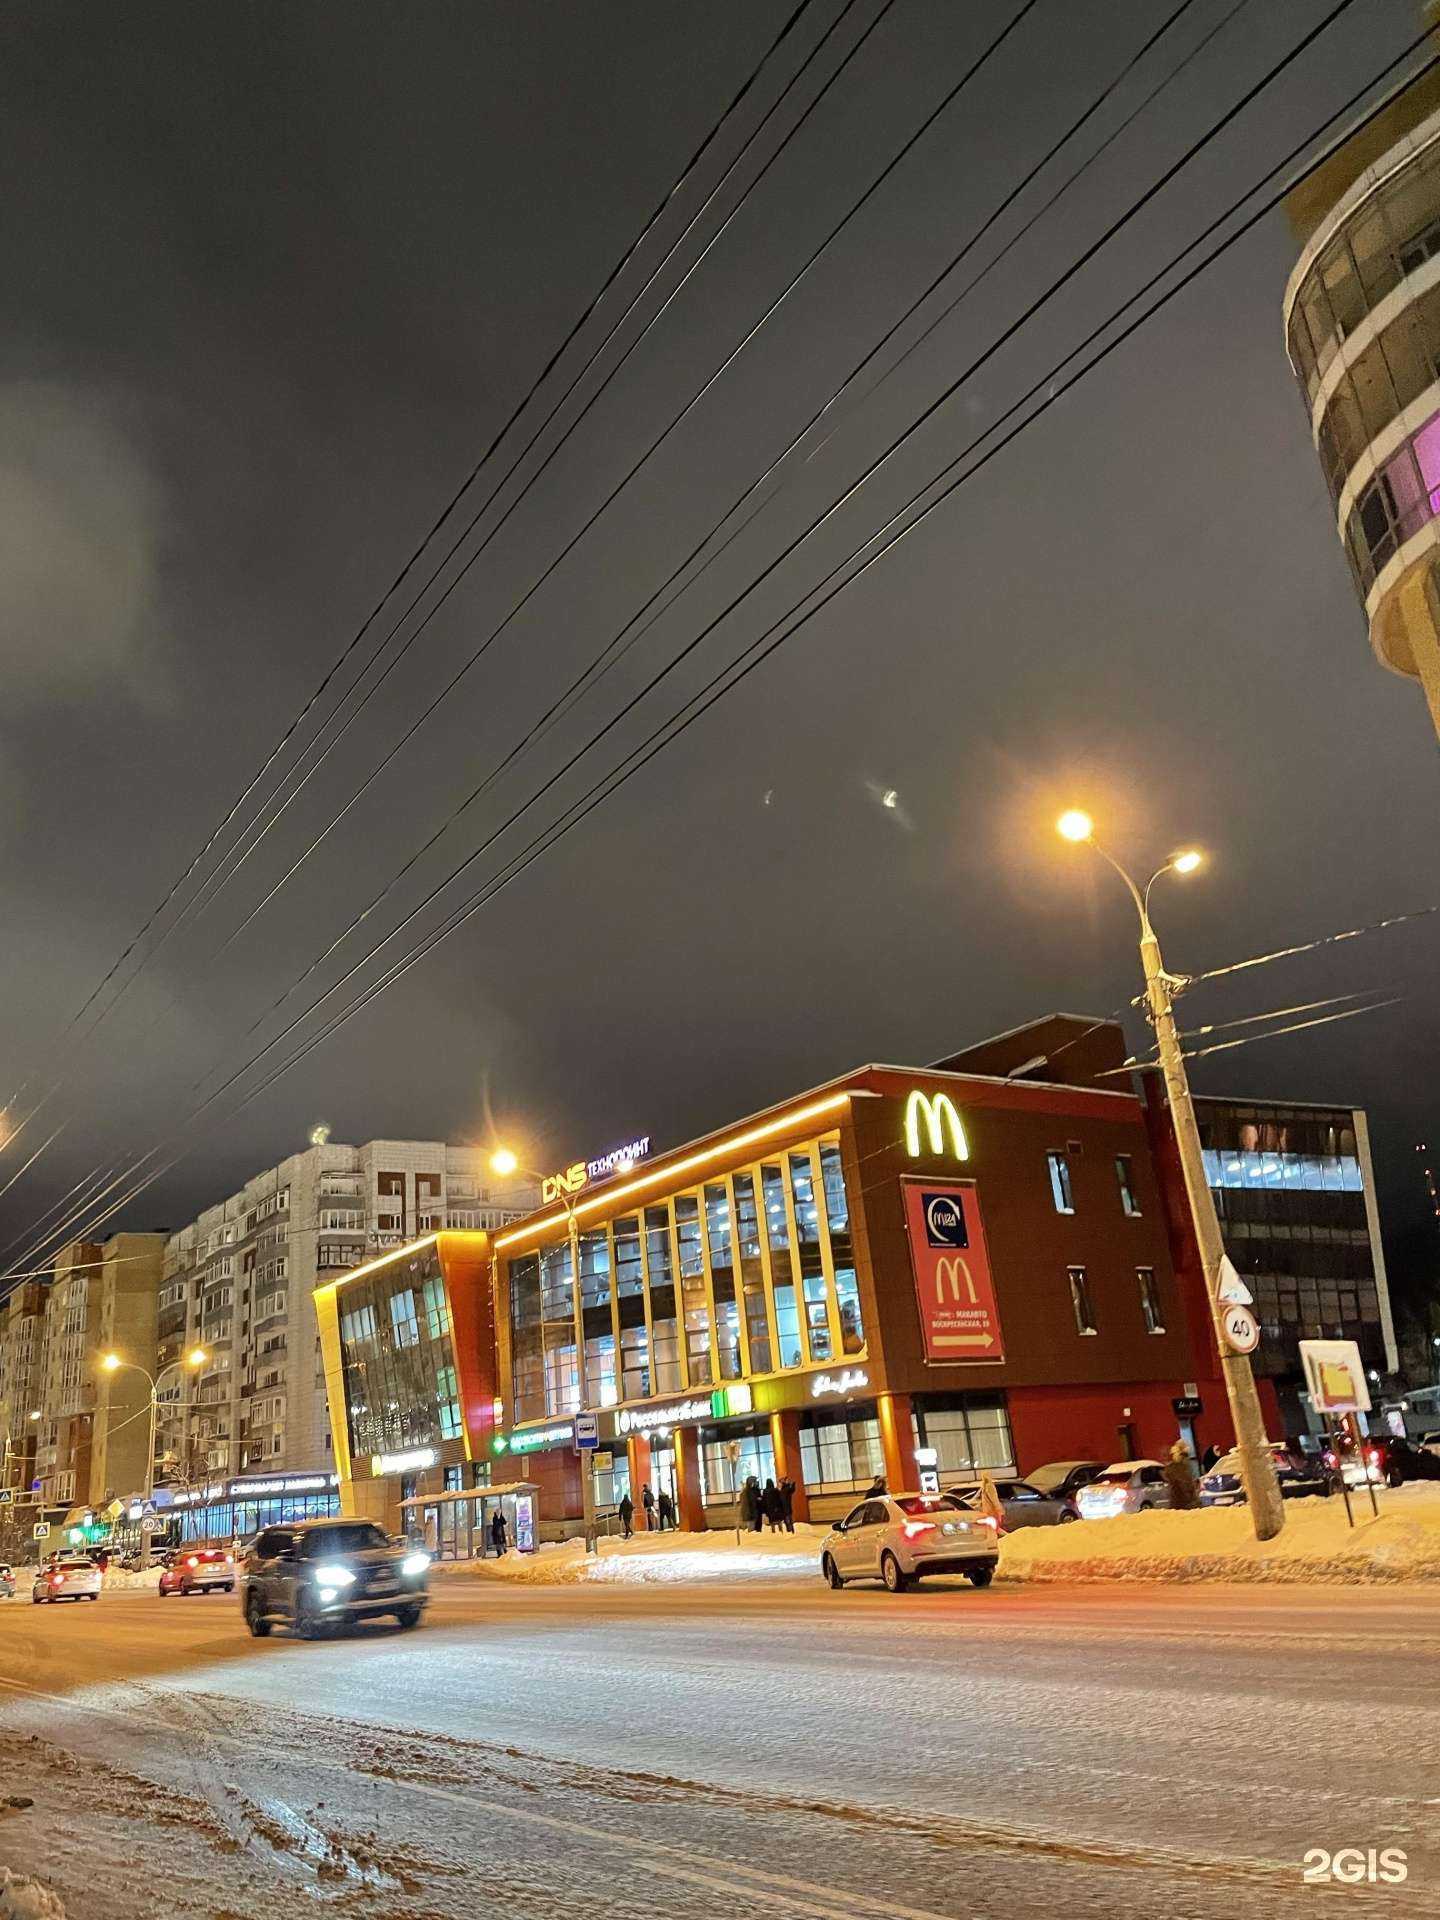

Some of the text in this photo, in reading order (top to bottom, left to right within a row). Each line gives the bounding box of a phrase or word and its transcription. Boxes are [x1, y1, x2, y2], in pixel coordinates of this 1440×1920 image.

[542, 1162, 587, 1204] DNS
[1232, 1320, 1250, 1337] 40
[144, 1520, 154, 1529] 20
